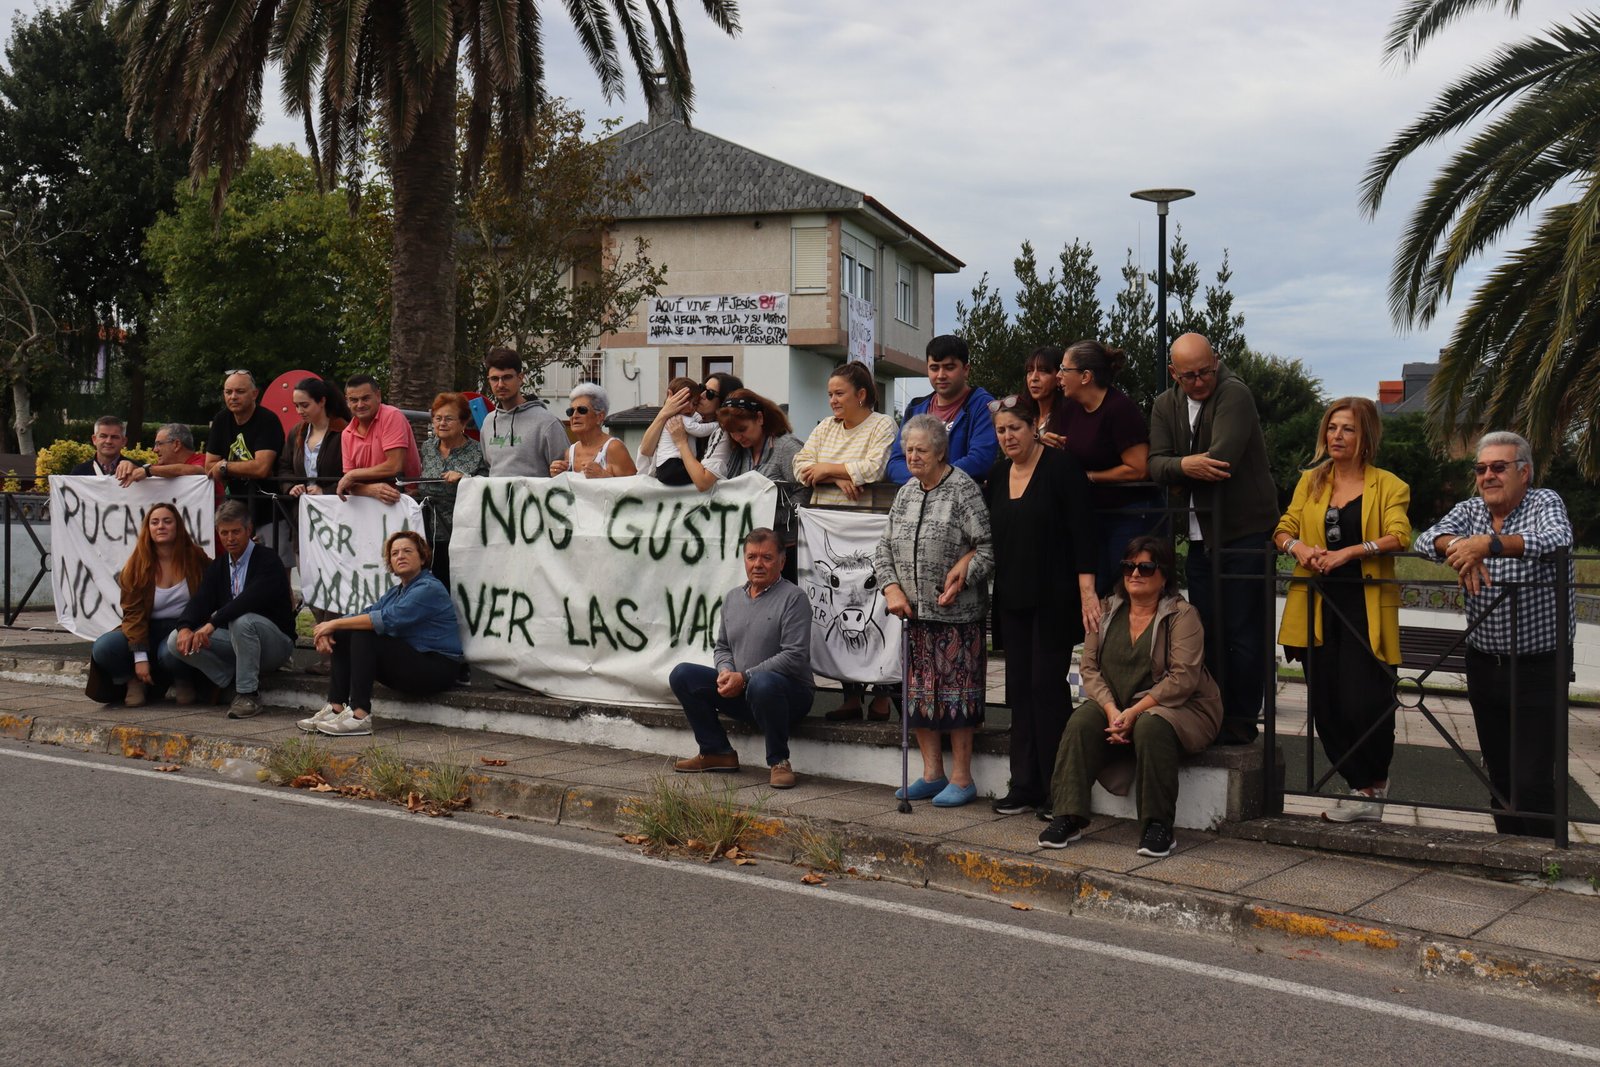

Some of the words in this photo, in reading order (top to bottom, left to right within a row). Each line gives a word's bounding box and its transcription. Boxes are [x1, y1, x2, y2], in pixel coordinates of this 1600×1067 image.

[649, 314, 671, 325] CASA
[674, 315, 701, 324] HECHA
[705, 315, 719, 325] POR
[744, 314, 749, 323] Y
[751, 315, 761, 323] SU
[655, 297, 683, 312] AQUÍ
[687, 300, 711, 311] VIVE
[758, 295, 776, 311] 84
[650, 325, 673, 338] AHORA
[674, 326, 684, 335] SE
[687, 326, 696, 335] LA
[767, 326, 787, 338] OTRA
[307, 503, 356, 557] POR
[480, 482, 575, 550] NOS
[60, 556, 102, 620] NO
[457, 583, 534, 647] VER
[563, 595, 648, 651] LAS
